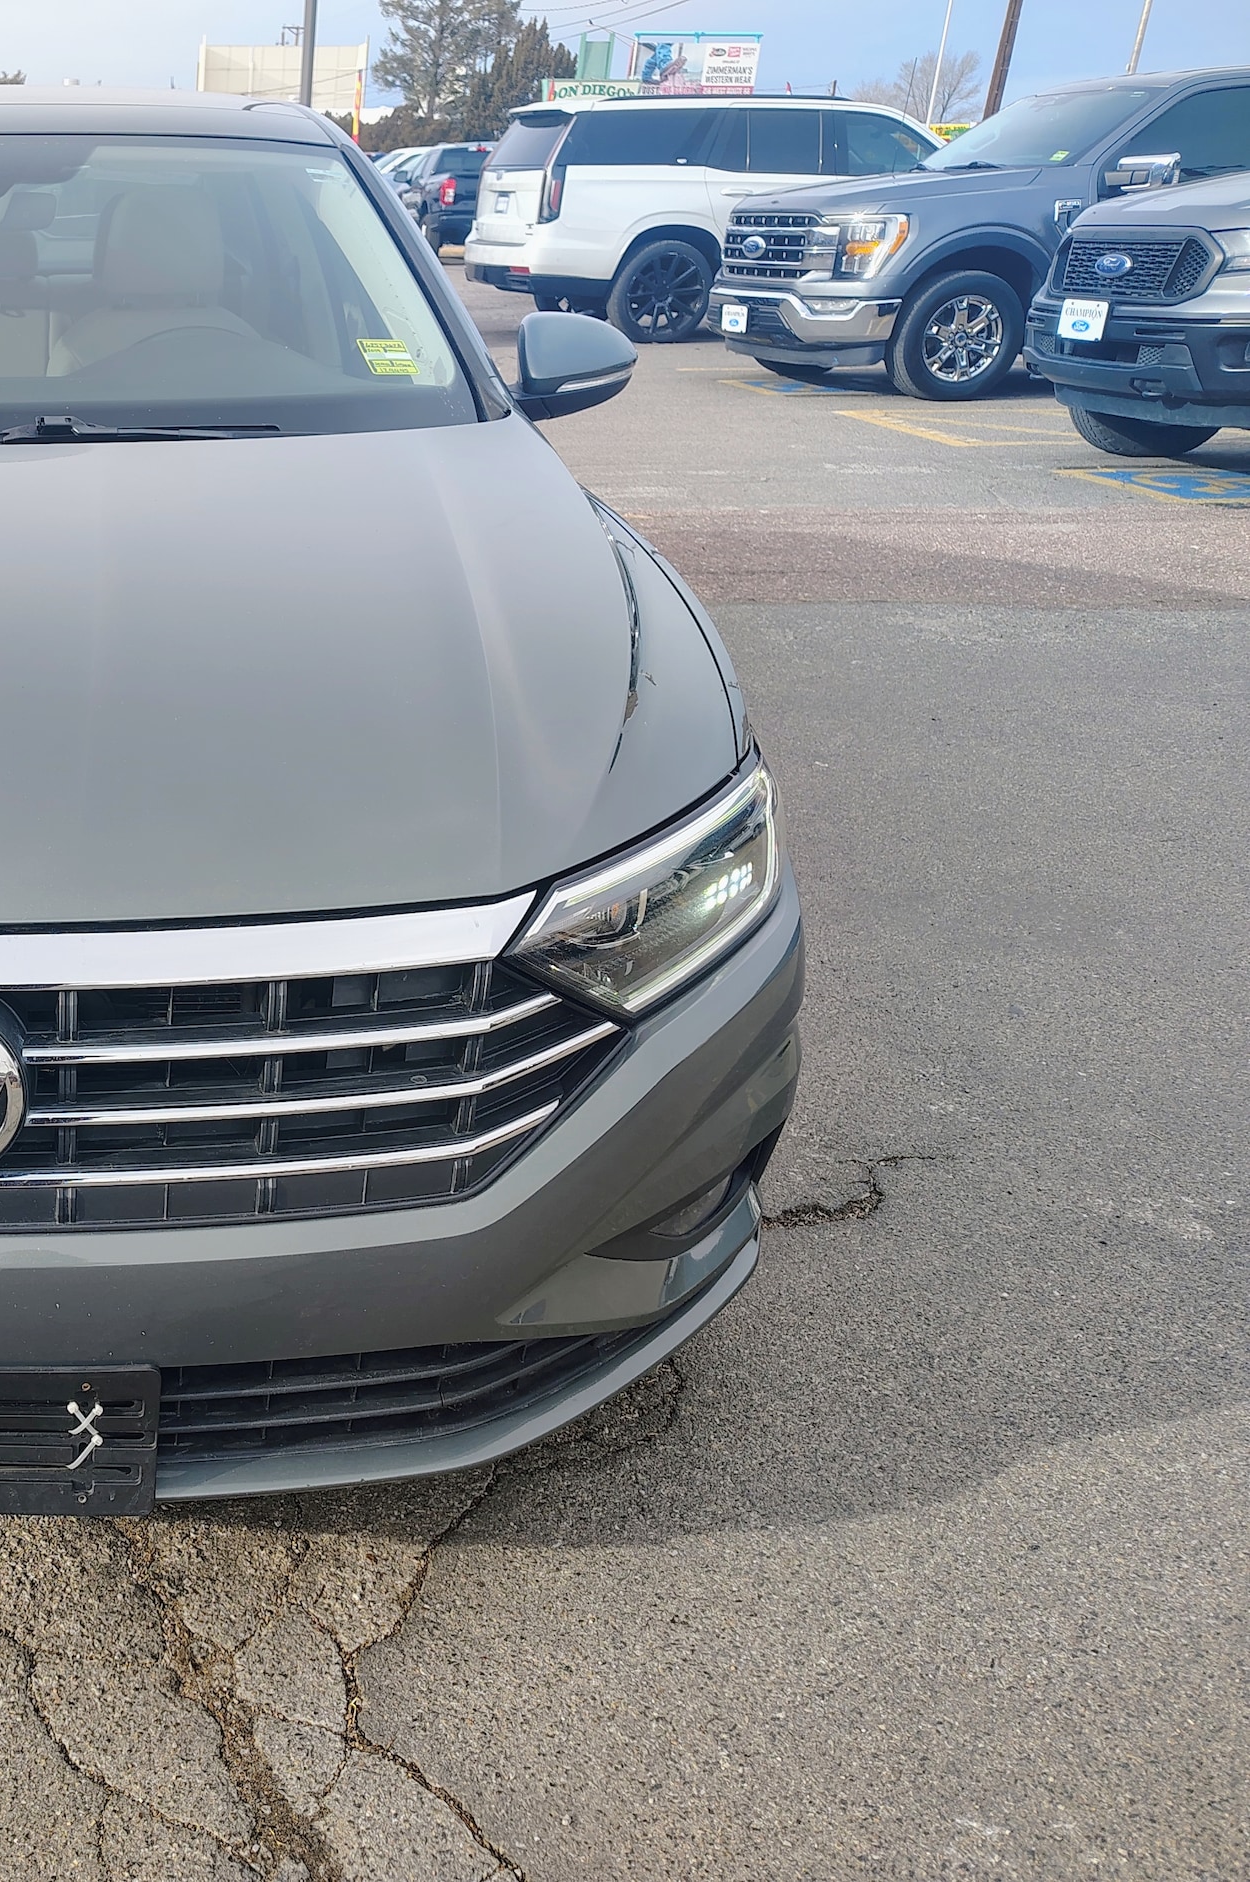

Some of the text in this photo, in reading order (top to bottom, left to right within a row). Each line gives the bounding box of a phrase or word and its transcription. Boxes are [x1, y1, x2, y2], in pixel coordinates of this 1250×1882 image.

[706, 66, 753, 75] ZIMMERMAN'S
[705, 75, 752, 84] WESTERN WEAR
[1065, 306, 1103, 320] CHAMPION
